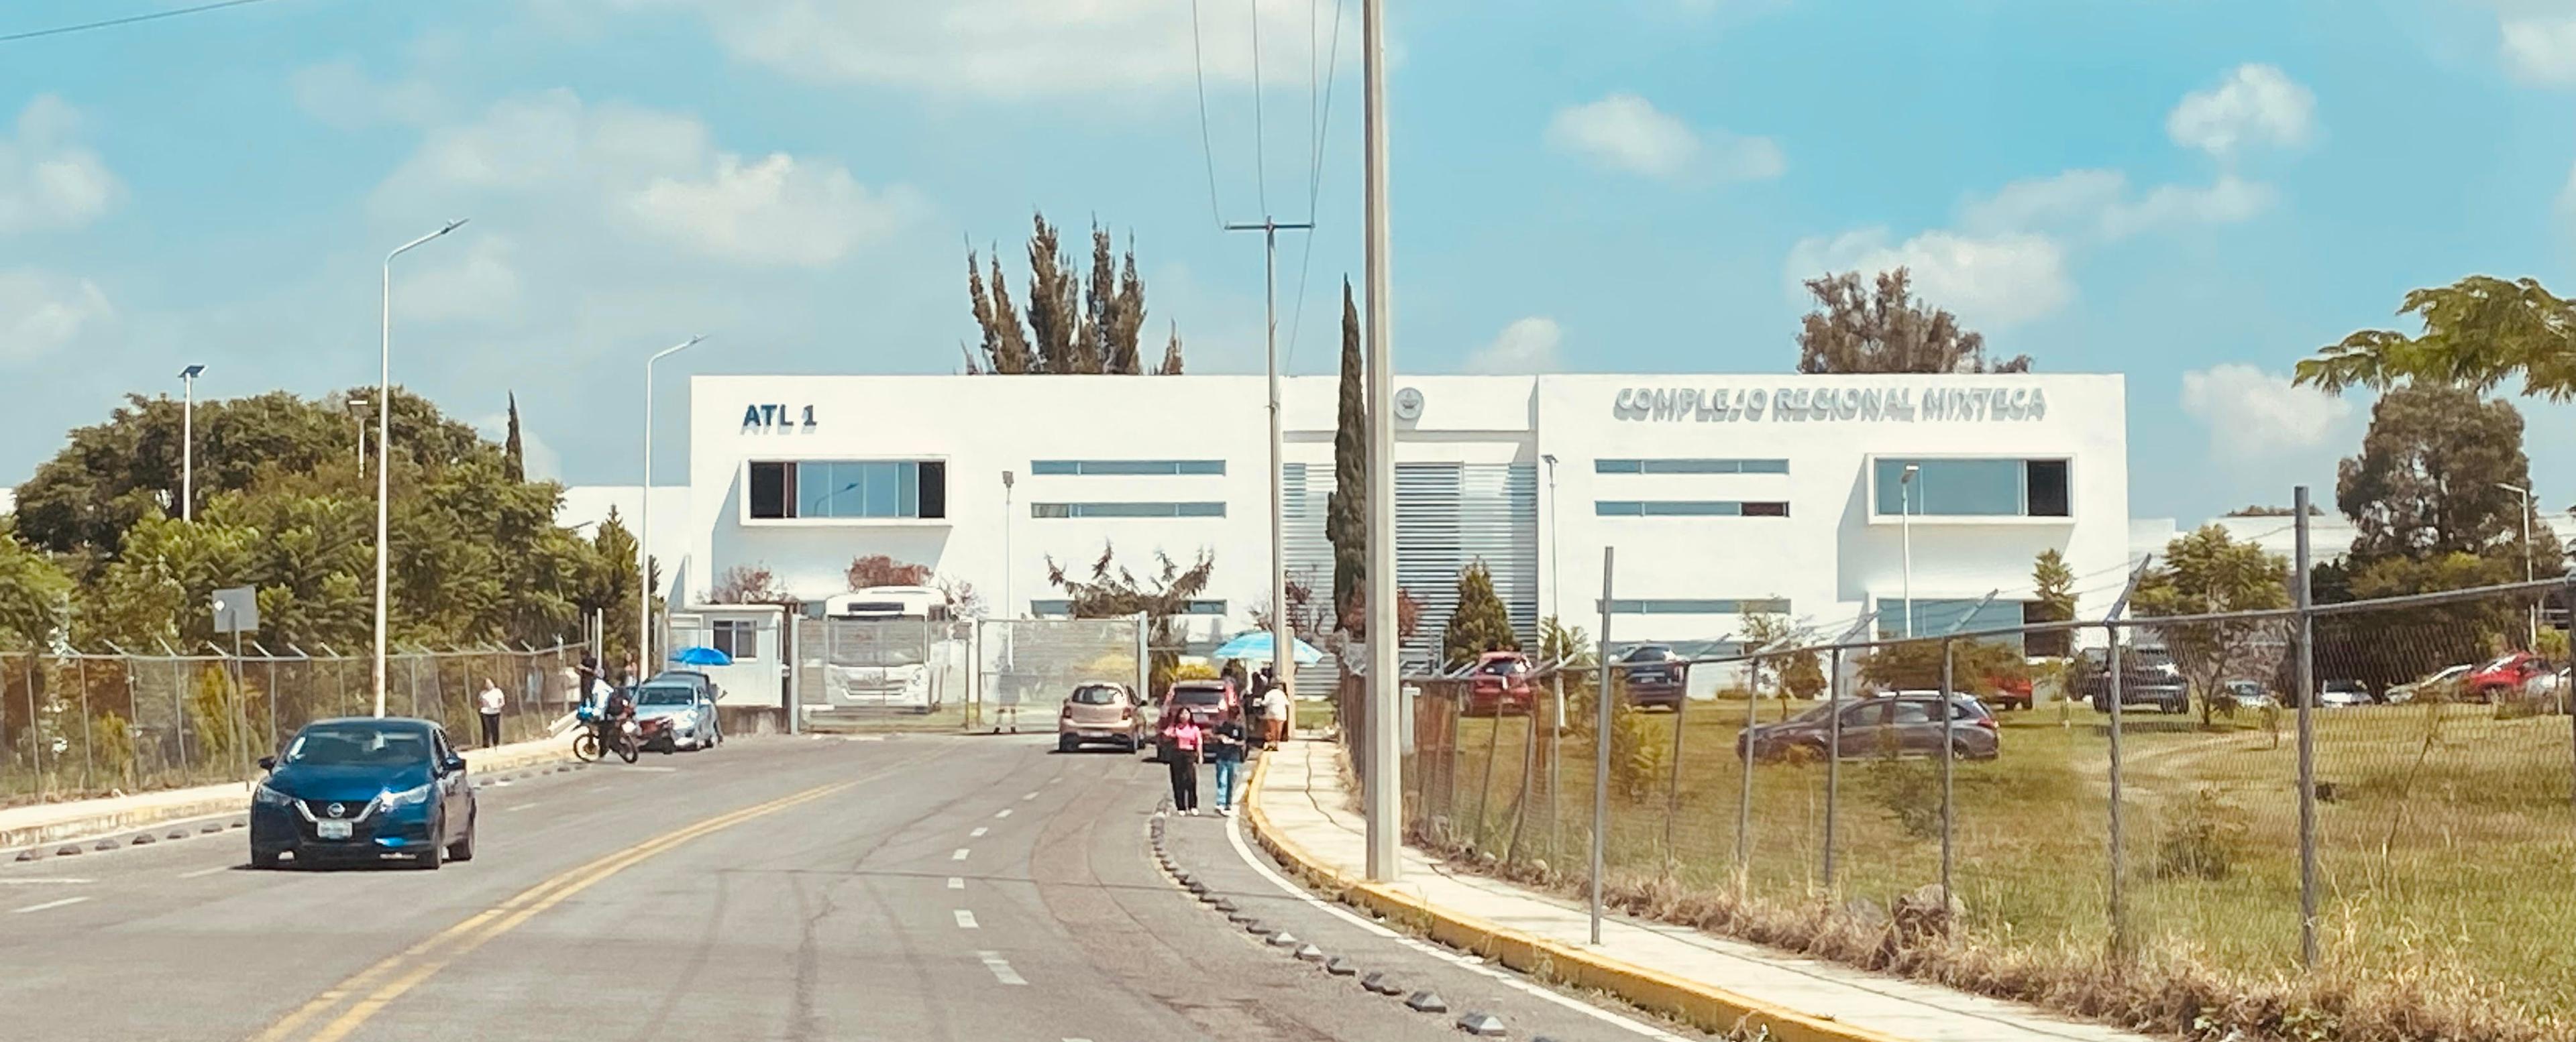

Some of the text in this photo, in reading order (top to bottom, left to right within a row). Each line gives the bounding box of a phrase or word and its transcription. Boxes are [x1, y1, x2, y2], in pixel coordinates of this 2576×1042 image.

[1614, 388, 2047, 414] COMPLEJO REGIONAL MIXTECA
[742, 404, 818, 427] ATL 1
